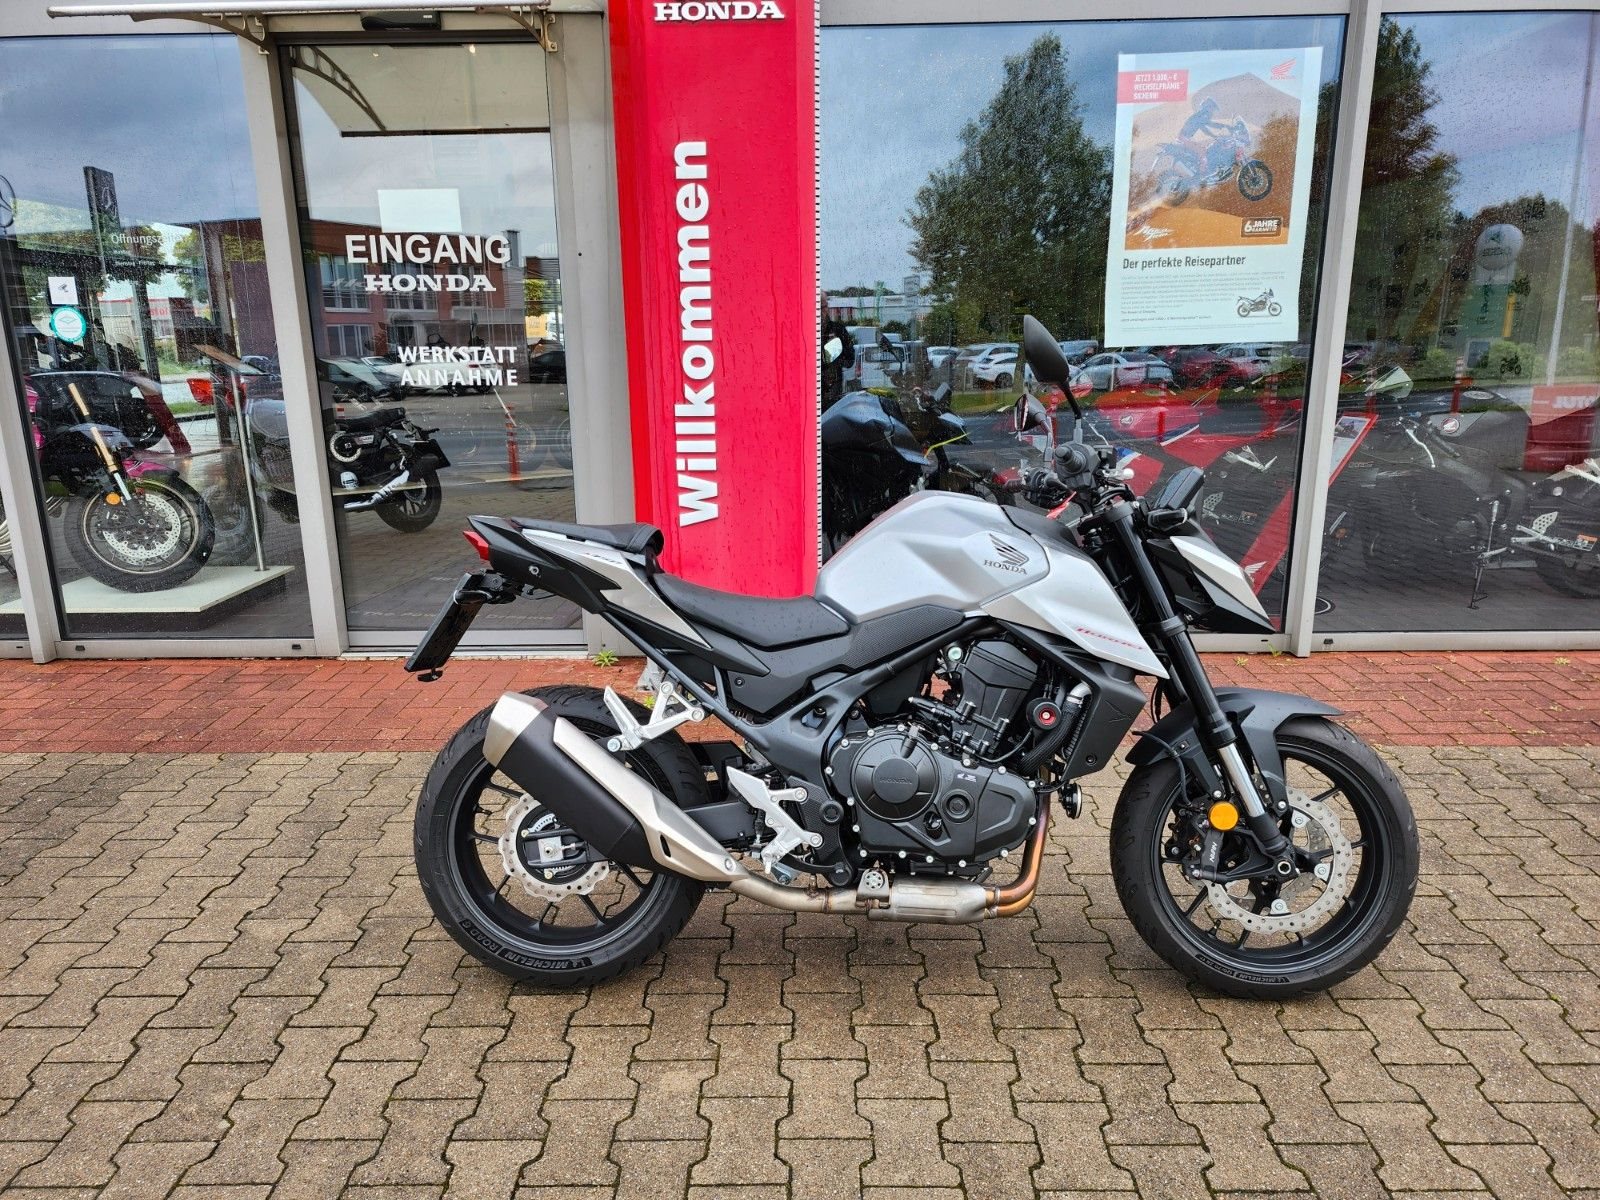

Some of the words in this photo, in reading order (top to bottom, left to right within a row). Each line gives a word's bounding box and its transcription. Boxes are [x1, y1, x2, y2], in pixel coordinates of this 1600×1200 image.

[653, 1, 785, 21] HONDA
[1244, 220, 1253, 233] 6
[1253, 219, 1279, 228] JAHRE
[345, 234, 511, 264] EINGANG
[1122, 258, 1139, 269] Der
[1141, 256, 1183, 271] perfekte
[1184, 255, 1246, 269] Reisepartner
[363, 274, 497, 292] HONDA
[673, 140, 719, 527] Willkommen
[397, 345, 518, 364] WERKSTATT
[400, 369, 518, 386] ANNAHME
[983, 559, 1028, 575] HONDA
[461, 919, 472, 929] 6
[469, 927, 499, 951] ROAD
[504, 950, 569, 970] MICHELIN
[1238, 972, 1276, 983] MICHELIN
